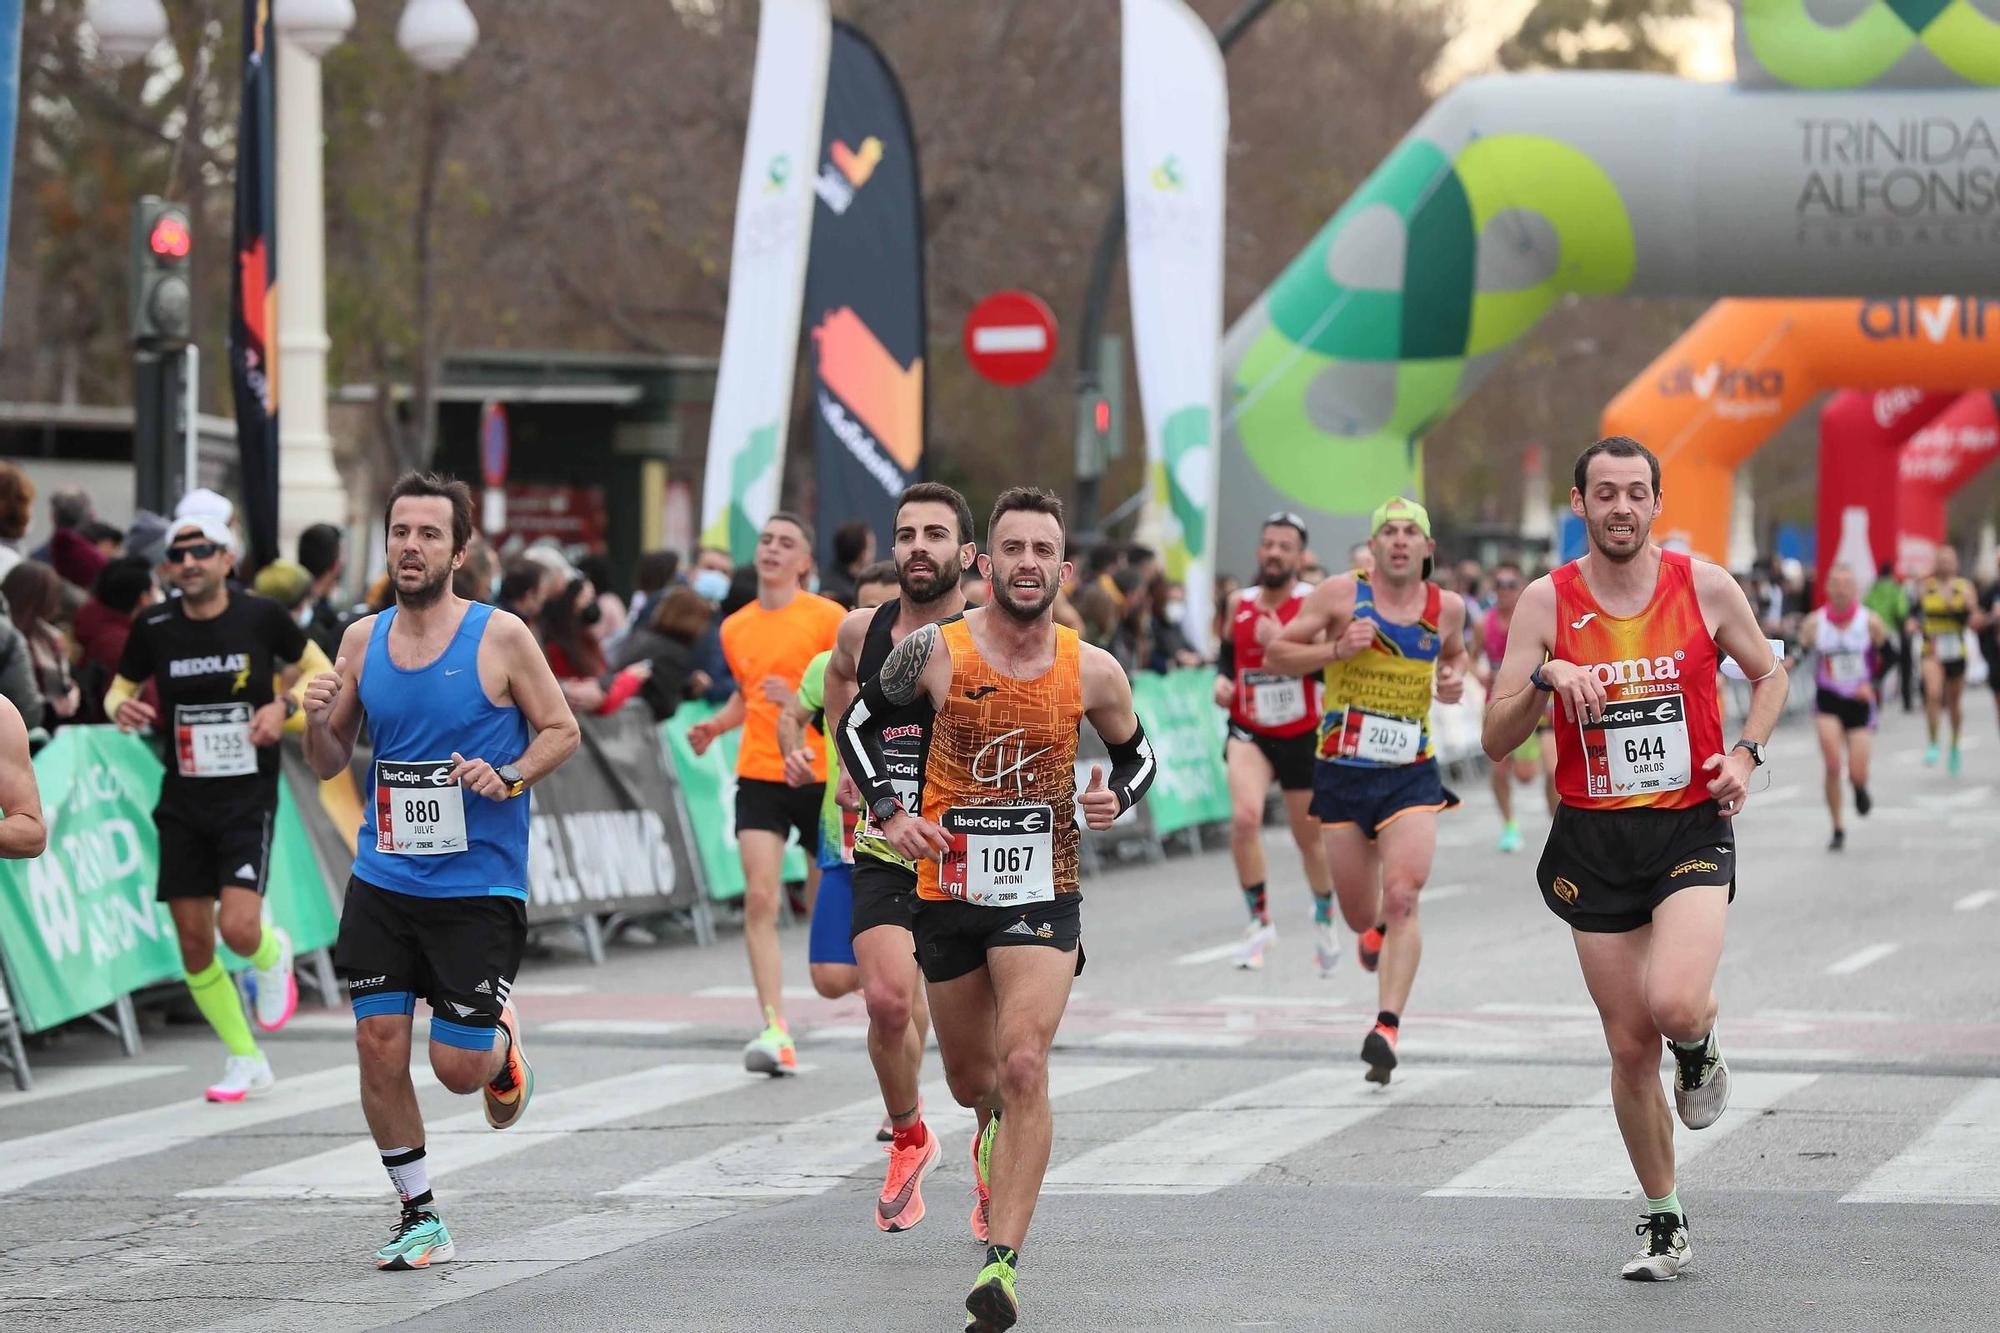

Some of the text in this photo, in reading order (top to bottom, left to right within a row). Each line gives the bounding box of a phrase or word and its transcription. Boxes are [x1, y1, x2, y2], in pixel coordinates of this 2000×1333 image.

[1796, 167, 2000, 217] ALFONS
[1621, 682, 1680, 696] almansa
[1369, 727, 1408, 748] 2075
[1624, 736, 1666, 763] 644
[1633, 762, 1665, 774] CARLOS
[382, 769, 421, 784] iberCaja
[405, 800, 440, 823] 880
[414, 825, 435, 834] JULVE
[953, 815, 1011, 831] iberCaja
[981, 846, 1034, 873] 1067
[993, 875, 1023, 885] ANTONI
[949, 882, 963, 896] 01
[998, 892, 1018, 901] 226ERS
